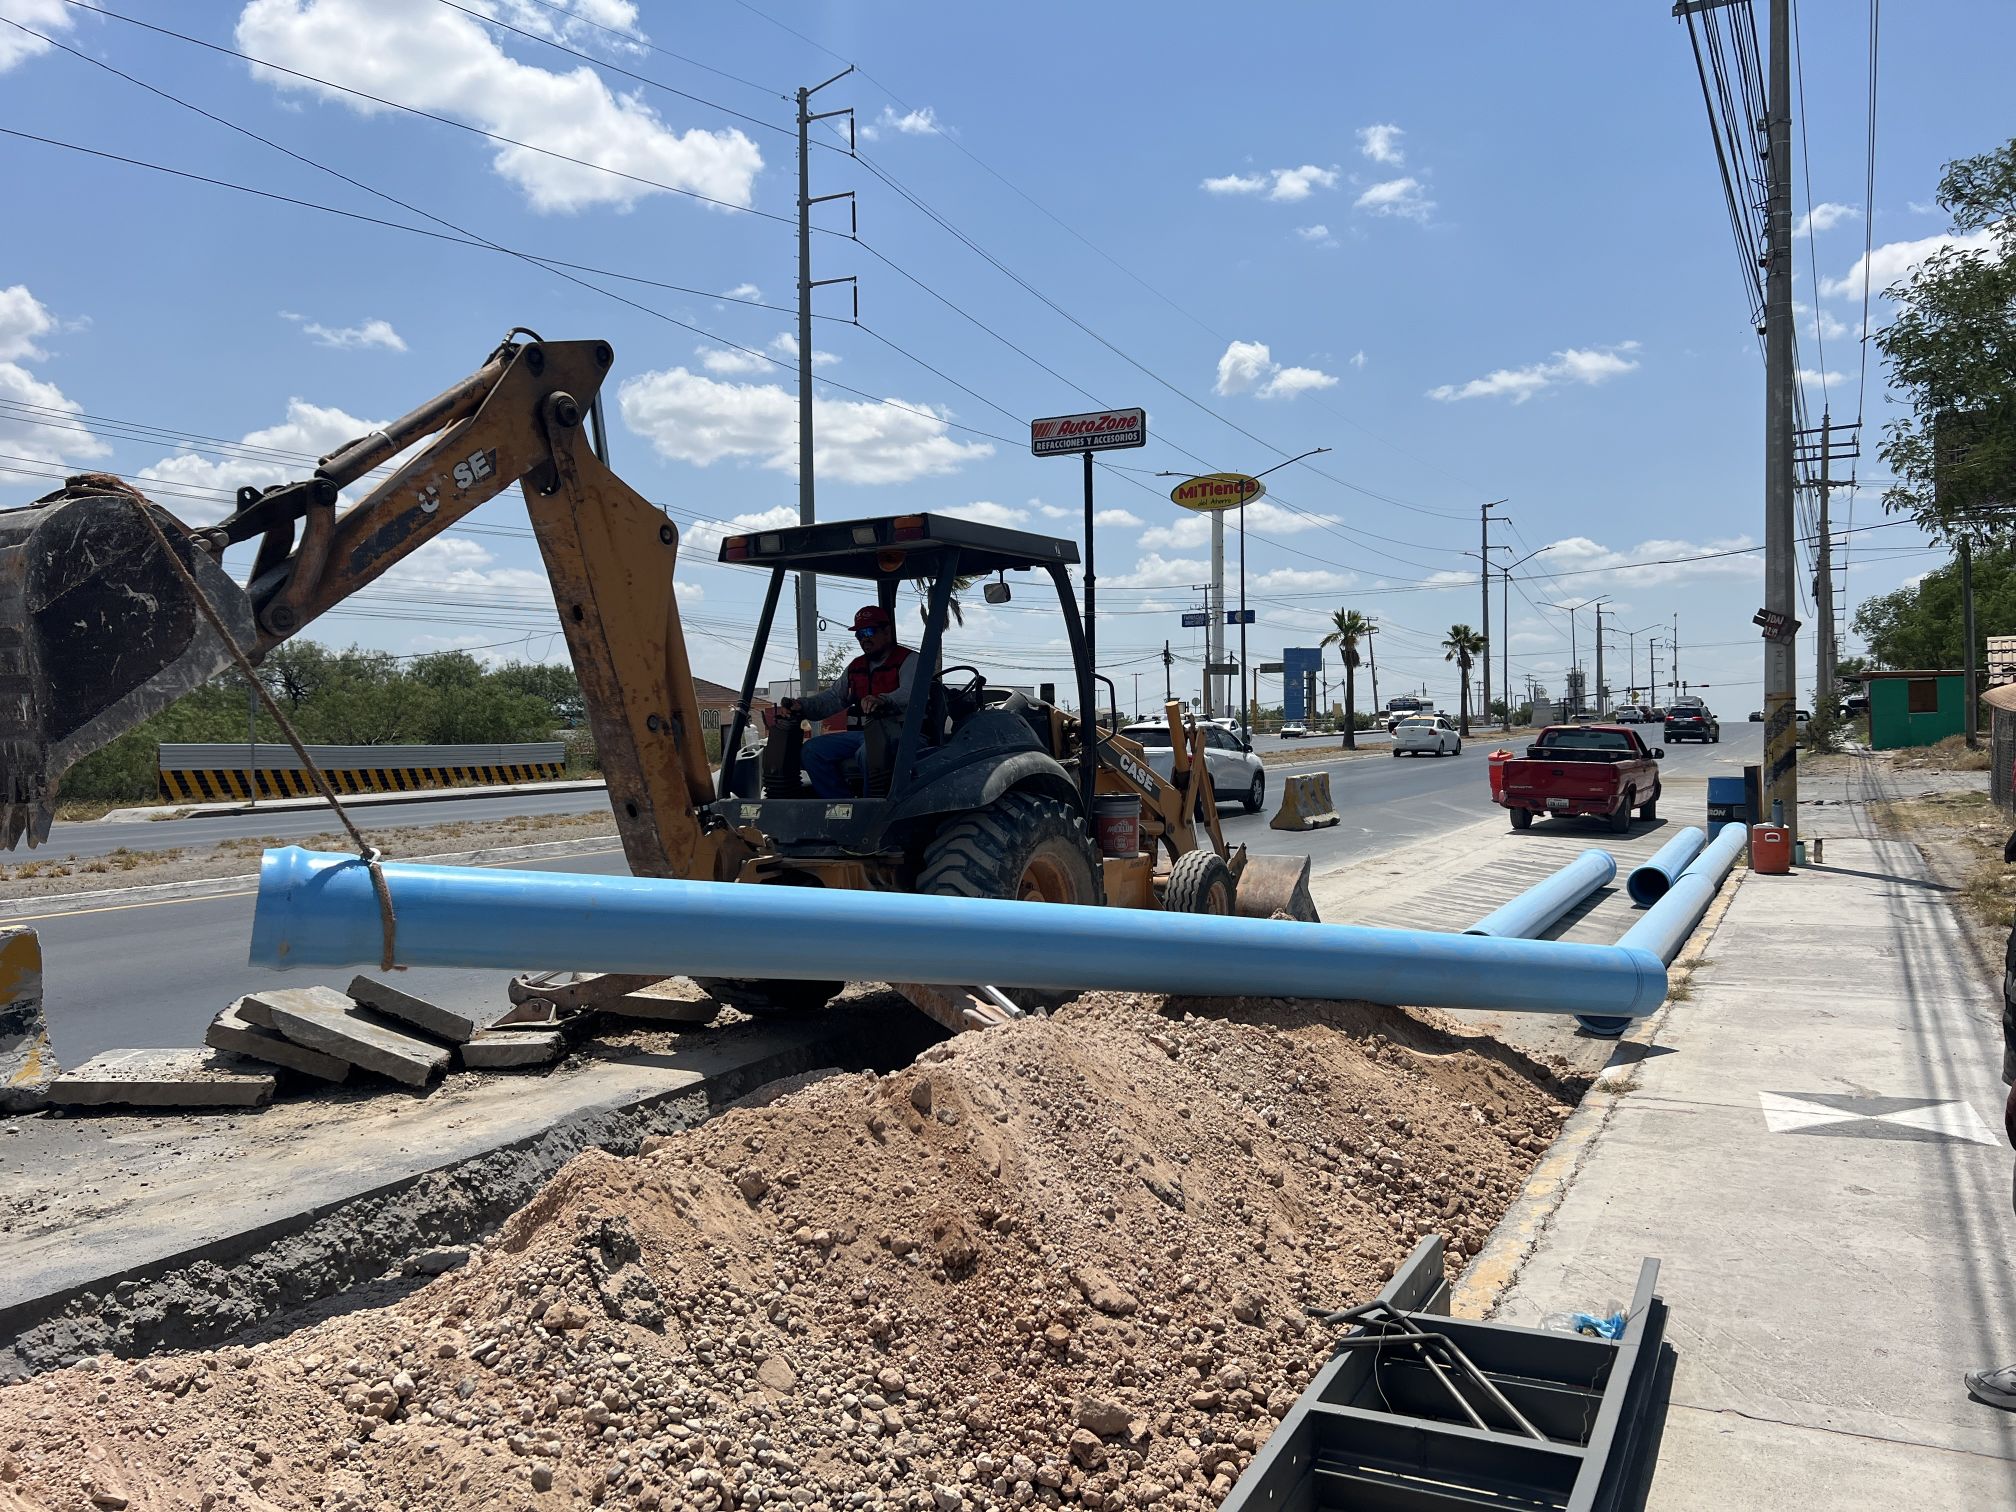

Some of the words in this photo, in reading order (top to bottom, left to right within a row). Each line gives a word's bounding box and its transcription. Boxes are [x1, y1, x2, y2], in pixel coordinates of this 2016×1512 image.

[1057, 415, 1138, 436] AutoZone
[1036, 438, 1084, 450] REFACCIONES
[1086, 437, 1092, 445] Y
[1094, 432, 1138, 445] ACCESORIOS
[418, 449, 491, 513] CSE
[1120, 753, 1154, 792] CASE
